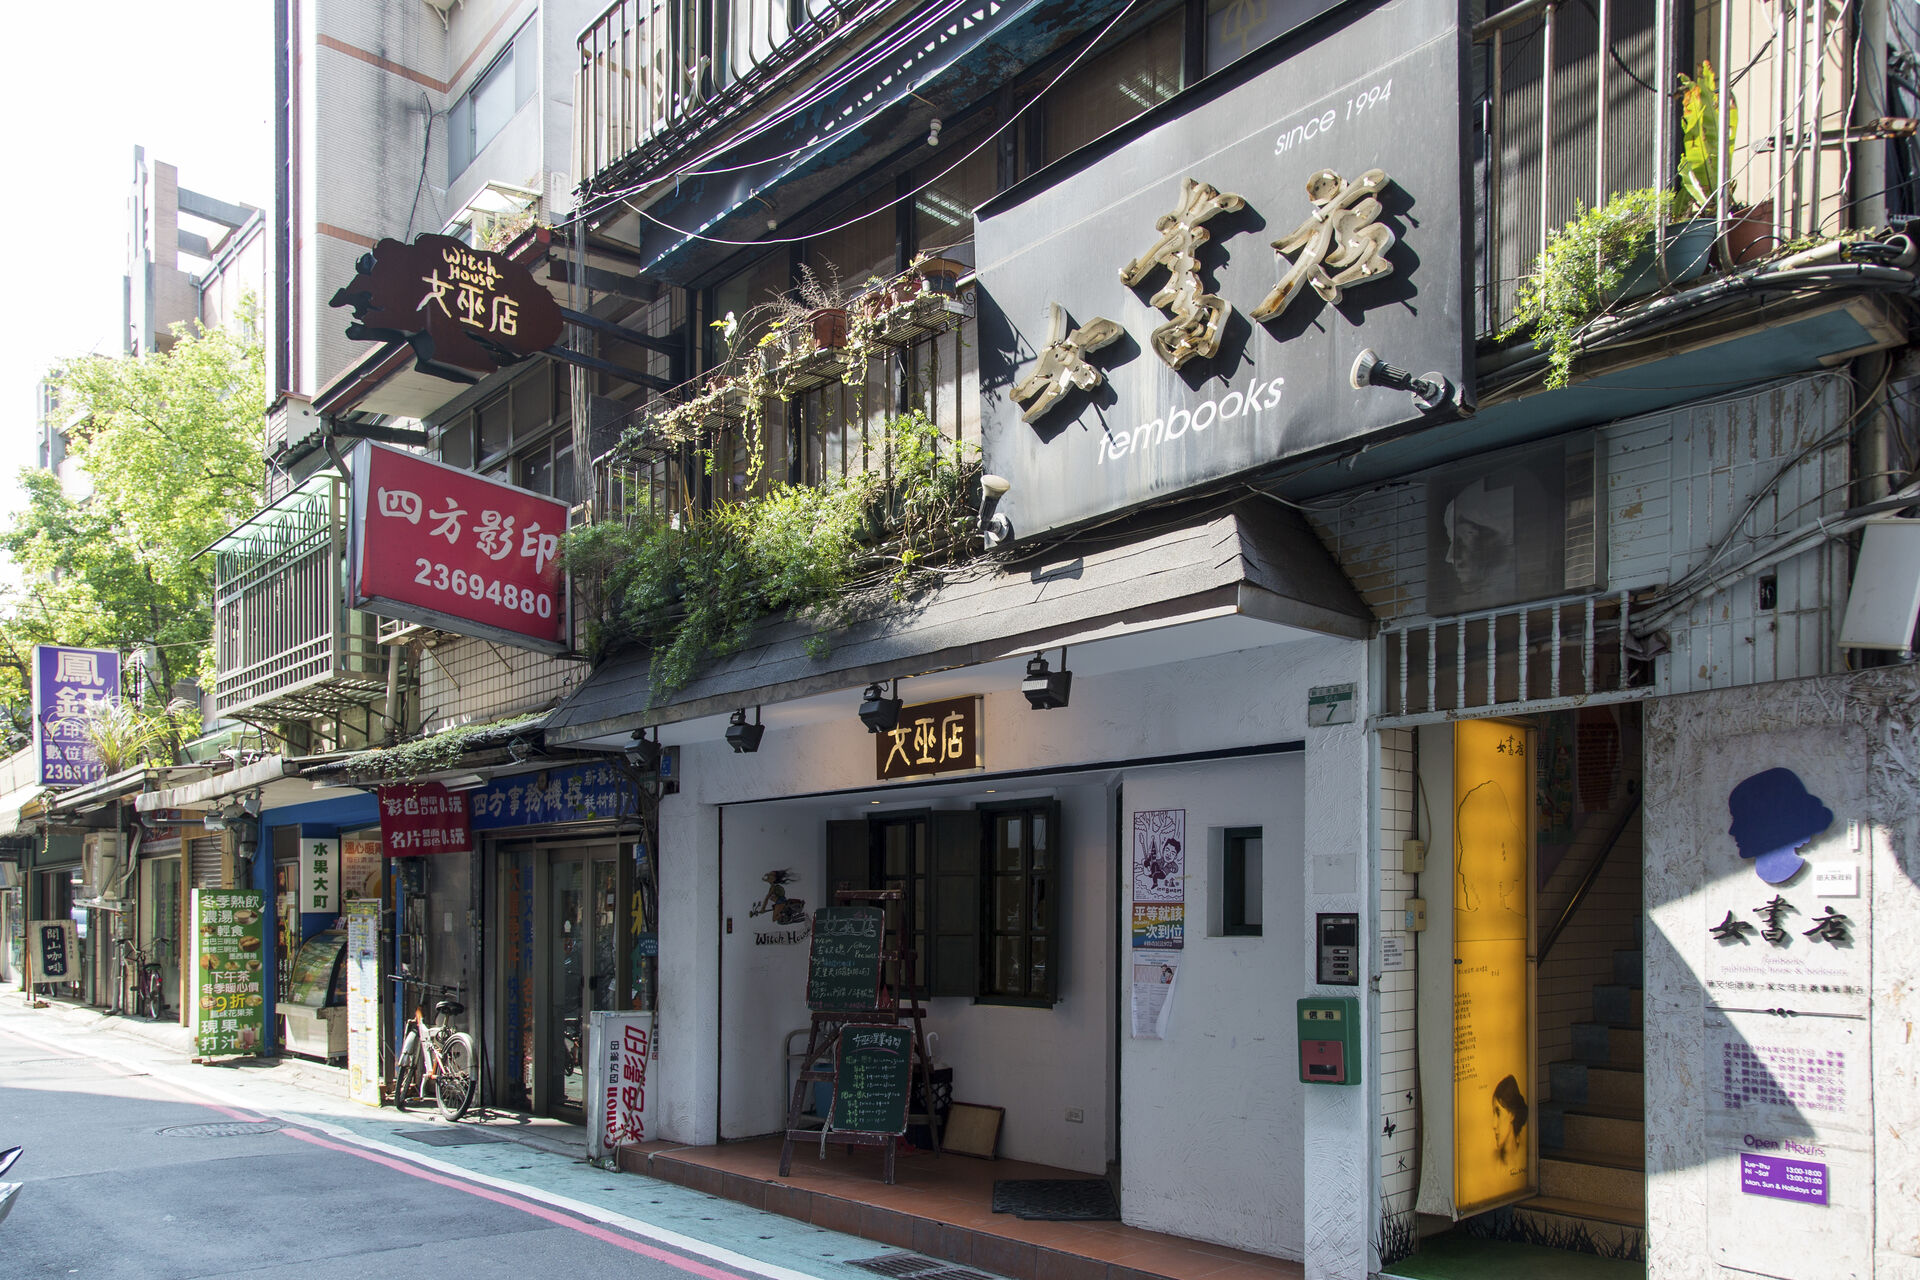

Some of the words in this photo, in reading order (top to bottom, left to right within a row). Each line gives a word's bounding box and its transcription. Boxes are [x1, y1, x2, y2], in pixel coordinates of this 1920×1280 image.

[1274, 109, 1336, 155] since
[1346, 78, 1393, 120] 1994
[442, 246, 504, 279] Witch
[448, 263, 496, 291] House
[416, 269, 519, 335] 女巫店
[1097, 377, 1285, 465] fembooks
[377, 486, 558, 574] 四方影印
[414, 557, 551, 618] 23694880
[1326, 703, 1338, 722] 7
[884, 710, 965, 773] 女巫店
[1497, 734, 1525, 756] 女書店
[421, 806, 438, 815] DM
[439, 796, 463, 813] 0.5元
[390, 830, 422, 849] 名片
[441, 828, 465, 845] 0.5元
[313, 842, 328, 908] 水果大町
[201, 895, 260, 909] 冬季熱飲
[202, 909, 233, 923] 濃湯
[1133, 906, 1183, 922] 平等就該
[1708, 894, 1848, 942] 女書店
[217, 925, 244, 937] 輕食
[754, 930, 785, 946] Witch
[1133, 924, 1183, 940] 一次到位
[210, 971, 250, 983] 下午茶
[216, 994, 246, 1012] 9折
[1308, 1010, 1335, 1020] 信箱
[609, 1040, 620, 1084] 四方影印
[619, 1024, 648, 1143] 彩色影印
[603, 1086, 618, 1149] Canon
[1744, 1134, 1779, 1149] Open
[1784, 1139, 1825, 1156] Hours
